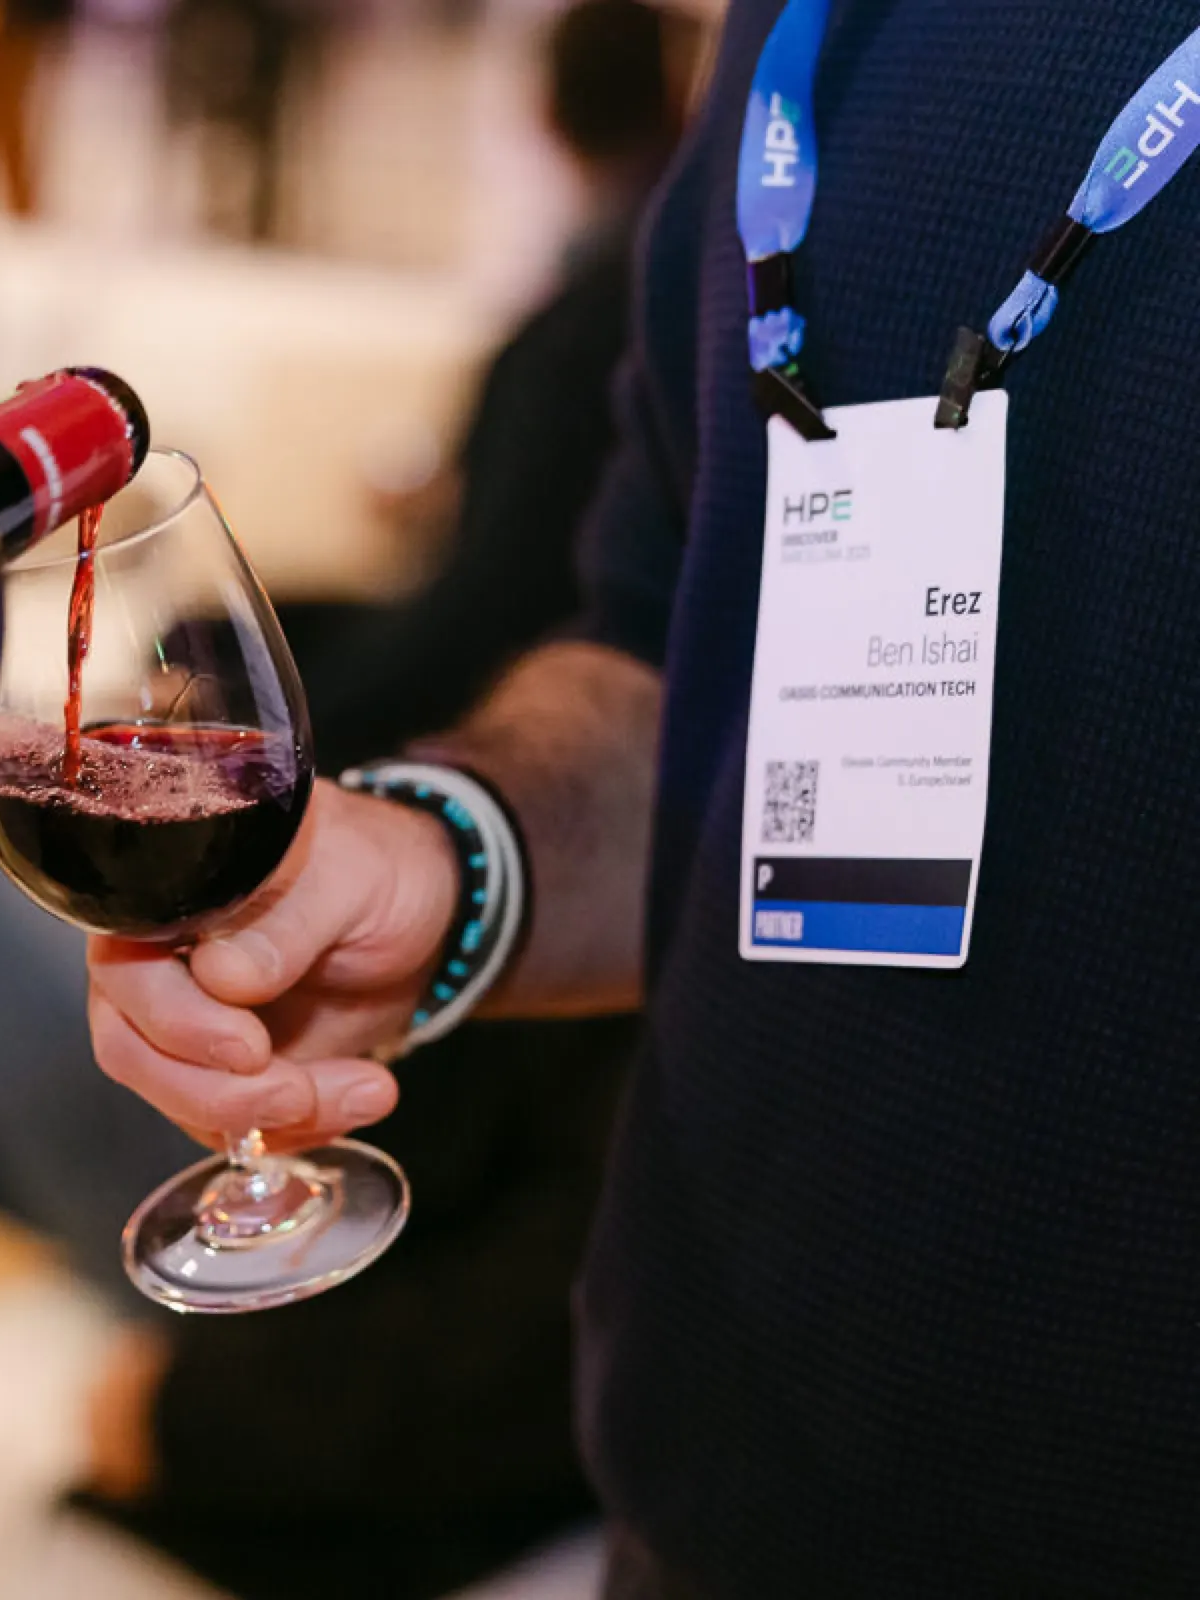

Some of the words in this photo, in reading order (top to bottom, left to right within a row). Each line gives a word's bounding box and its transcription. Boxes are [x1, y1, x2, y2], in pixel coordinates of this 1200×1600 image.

[1104, 80, 1200, 189] HPE
[782, 488, 853, 526] HPE
[925, 586, 982, 617] Erez
[867, 635, 913, 667] Ben
[921, 631, 978, 665] Ishai
[820, 681, 937, 700] COMMUNICATION
[940, 680, 975, 697] TECH
[933, 754, 972, 767] Member
[756, 863, 774, 892] P
